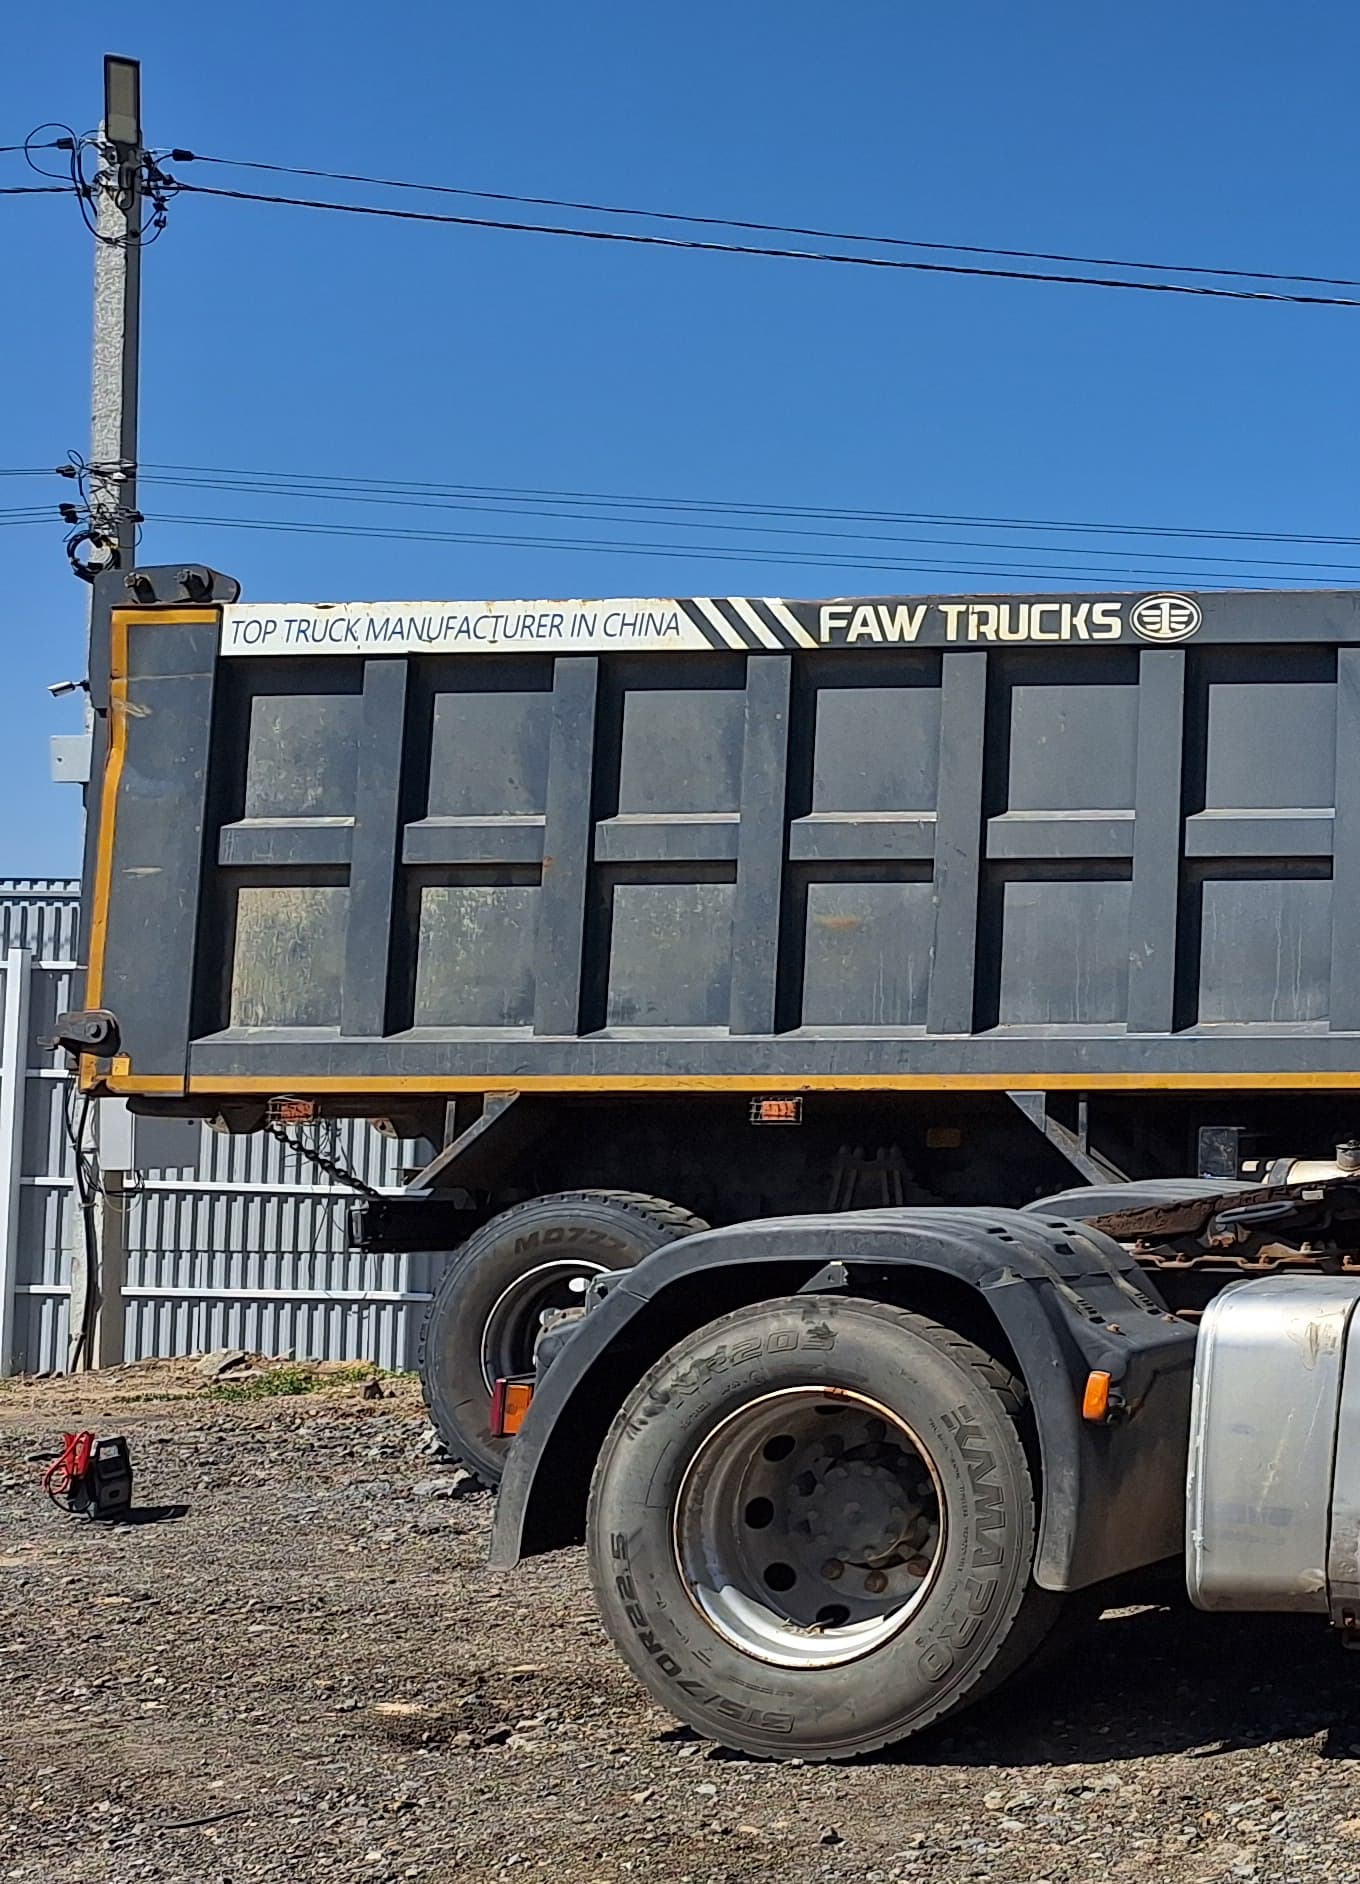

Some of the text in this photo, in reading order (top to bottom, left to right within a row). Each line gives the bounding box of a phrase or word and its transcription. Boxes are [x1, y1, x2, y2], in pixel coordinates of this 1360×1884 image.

[231, 612, 680, 645] TOP TRUCK MANUFACTURER IN CHINA
[819, 602, 1122, 643] FAW TRUCKS
[941, 1404, 1008, 1571] KAMA
[917, 1578, 1000, 1684] PRO
